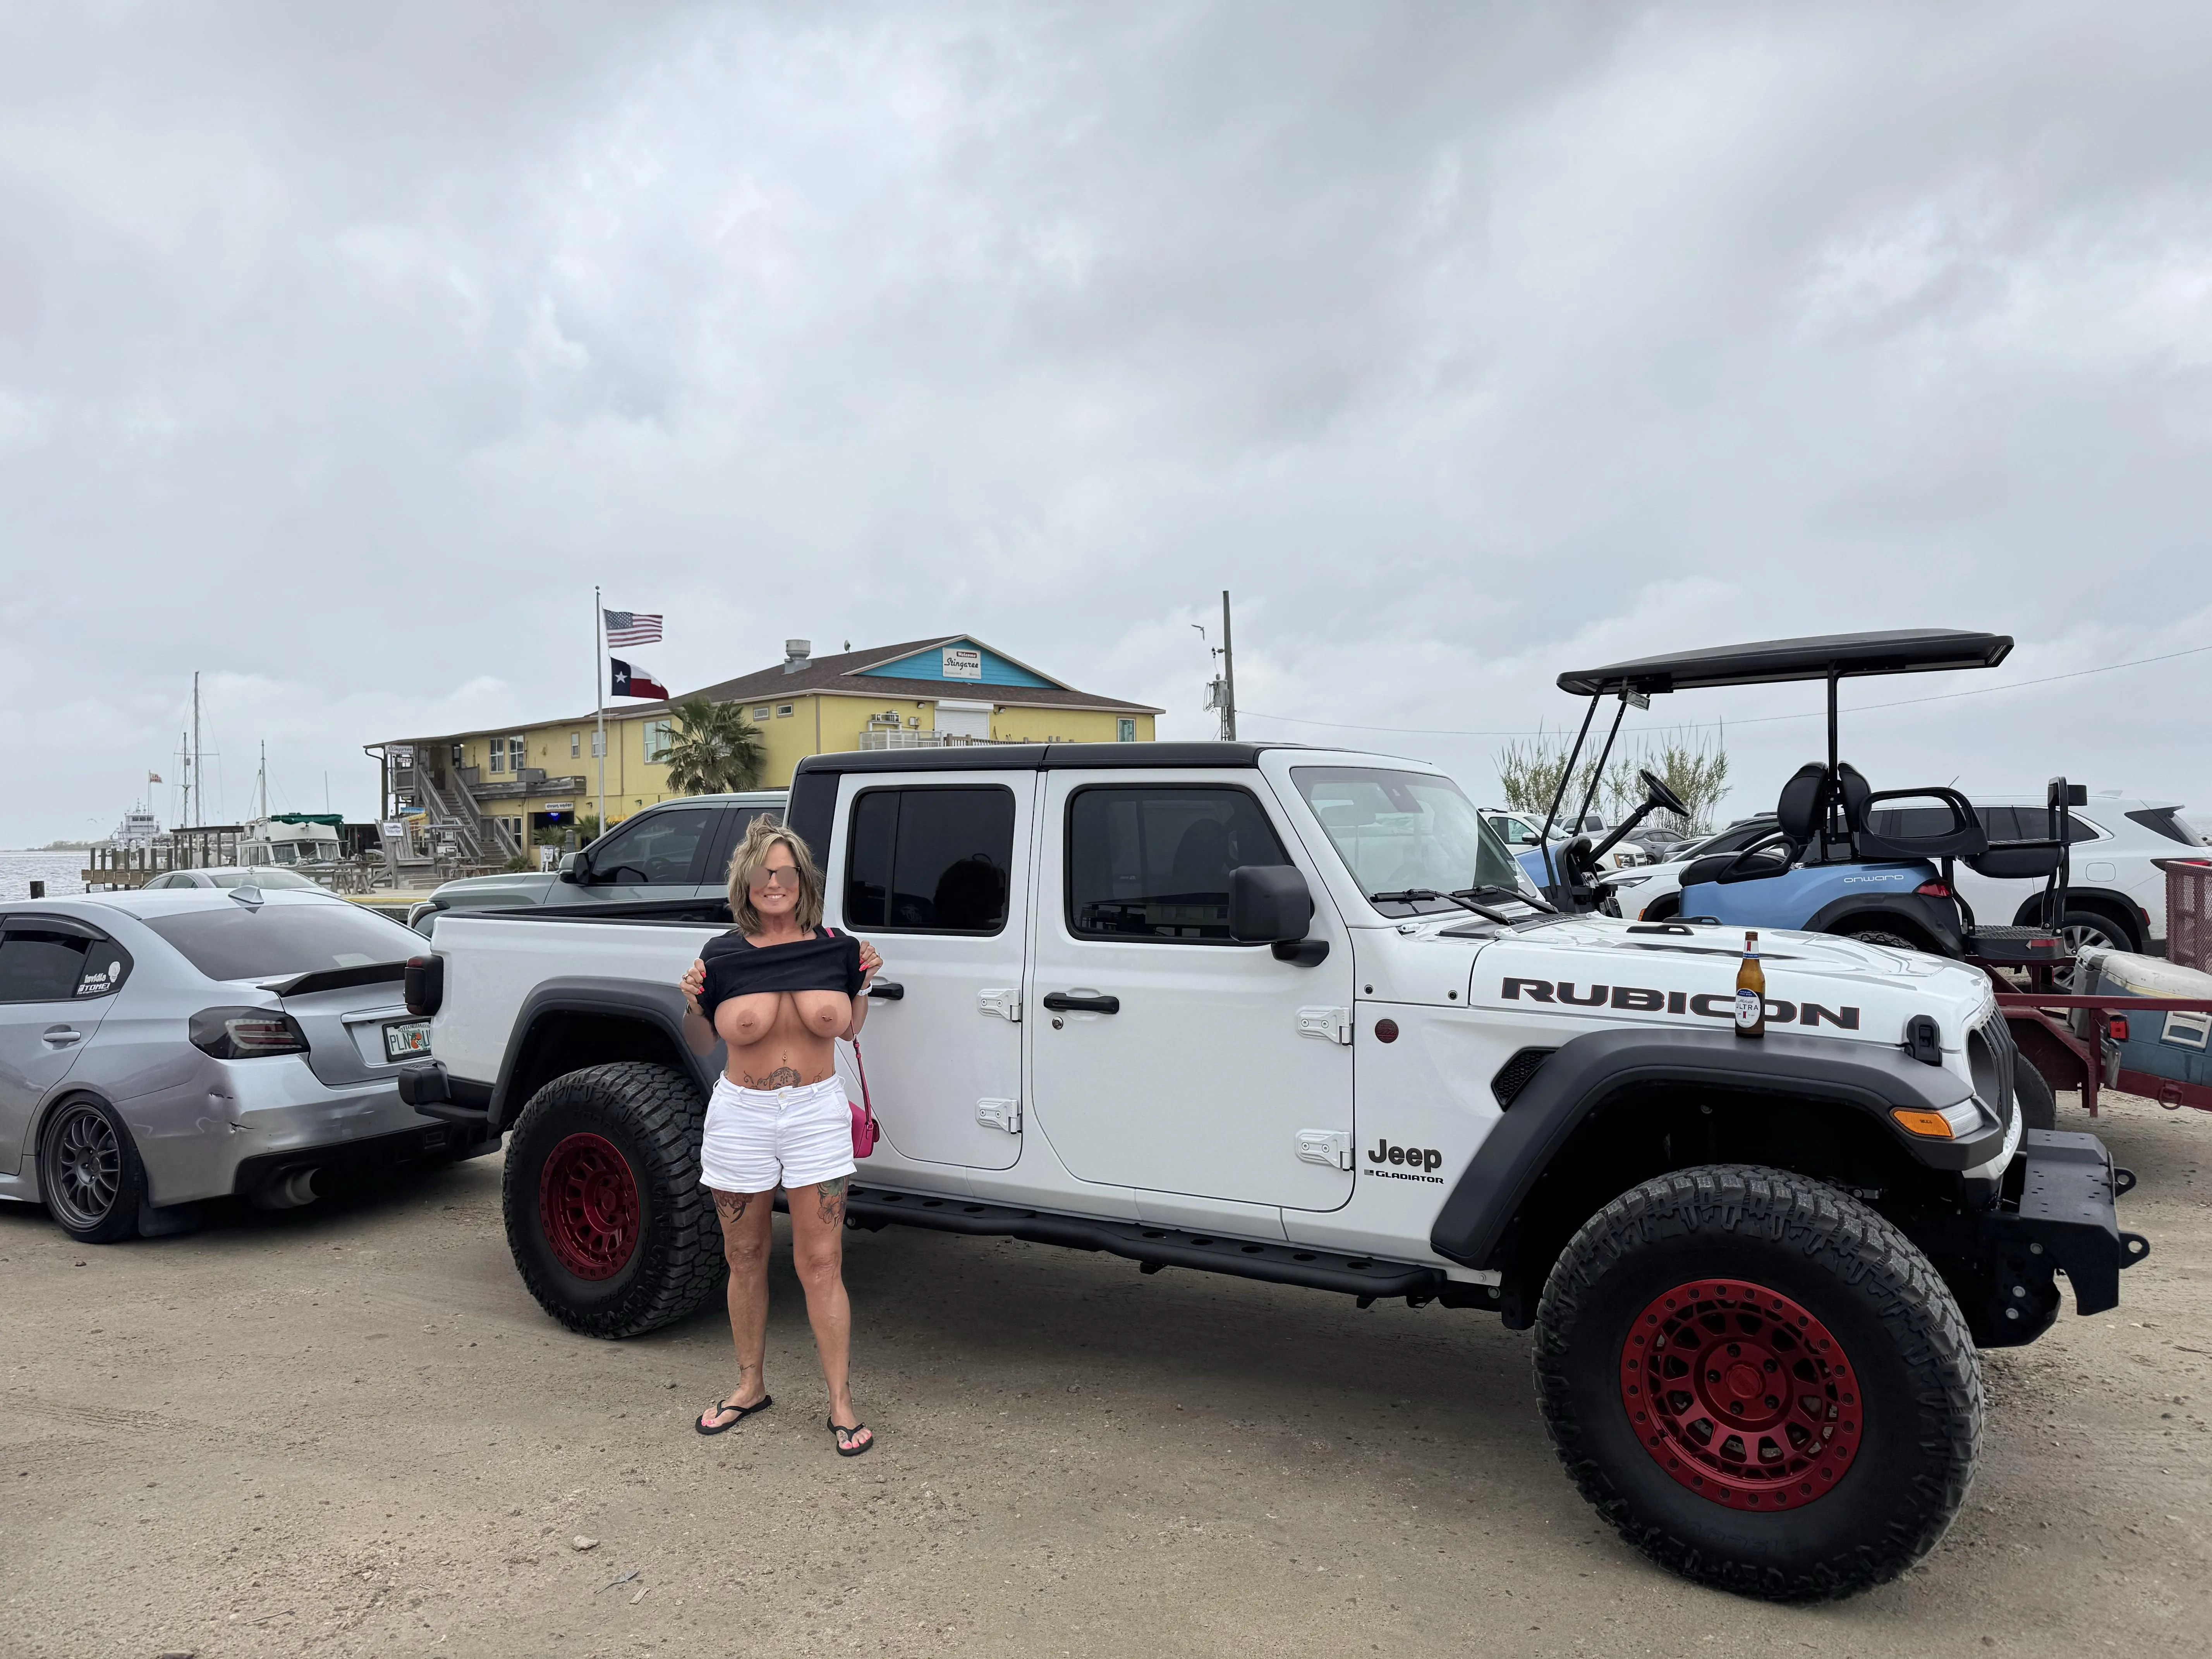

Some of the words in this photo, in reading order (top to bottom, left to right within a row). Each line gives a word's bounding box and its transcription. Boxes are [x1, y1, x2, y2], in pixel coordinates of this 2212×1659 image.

[944, 657, 979, 670] Stingaree
[85, 982, 110, 991] TOMEI
[1501, 976, 1860, 1030] RUBICON
[390, 1033, 411, 1051] PLN
[1368, 1139, 1442, 1173] Jeep
[1376, 1170, 1444, 1184] GLADIATOR
